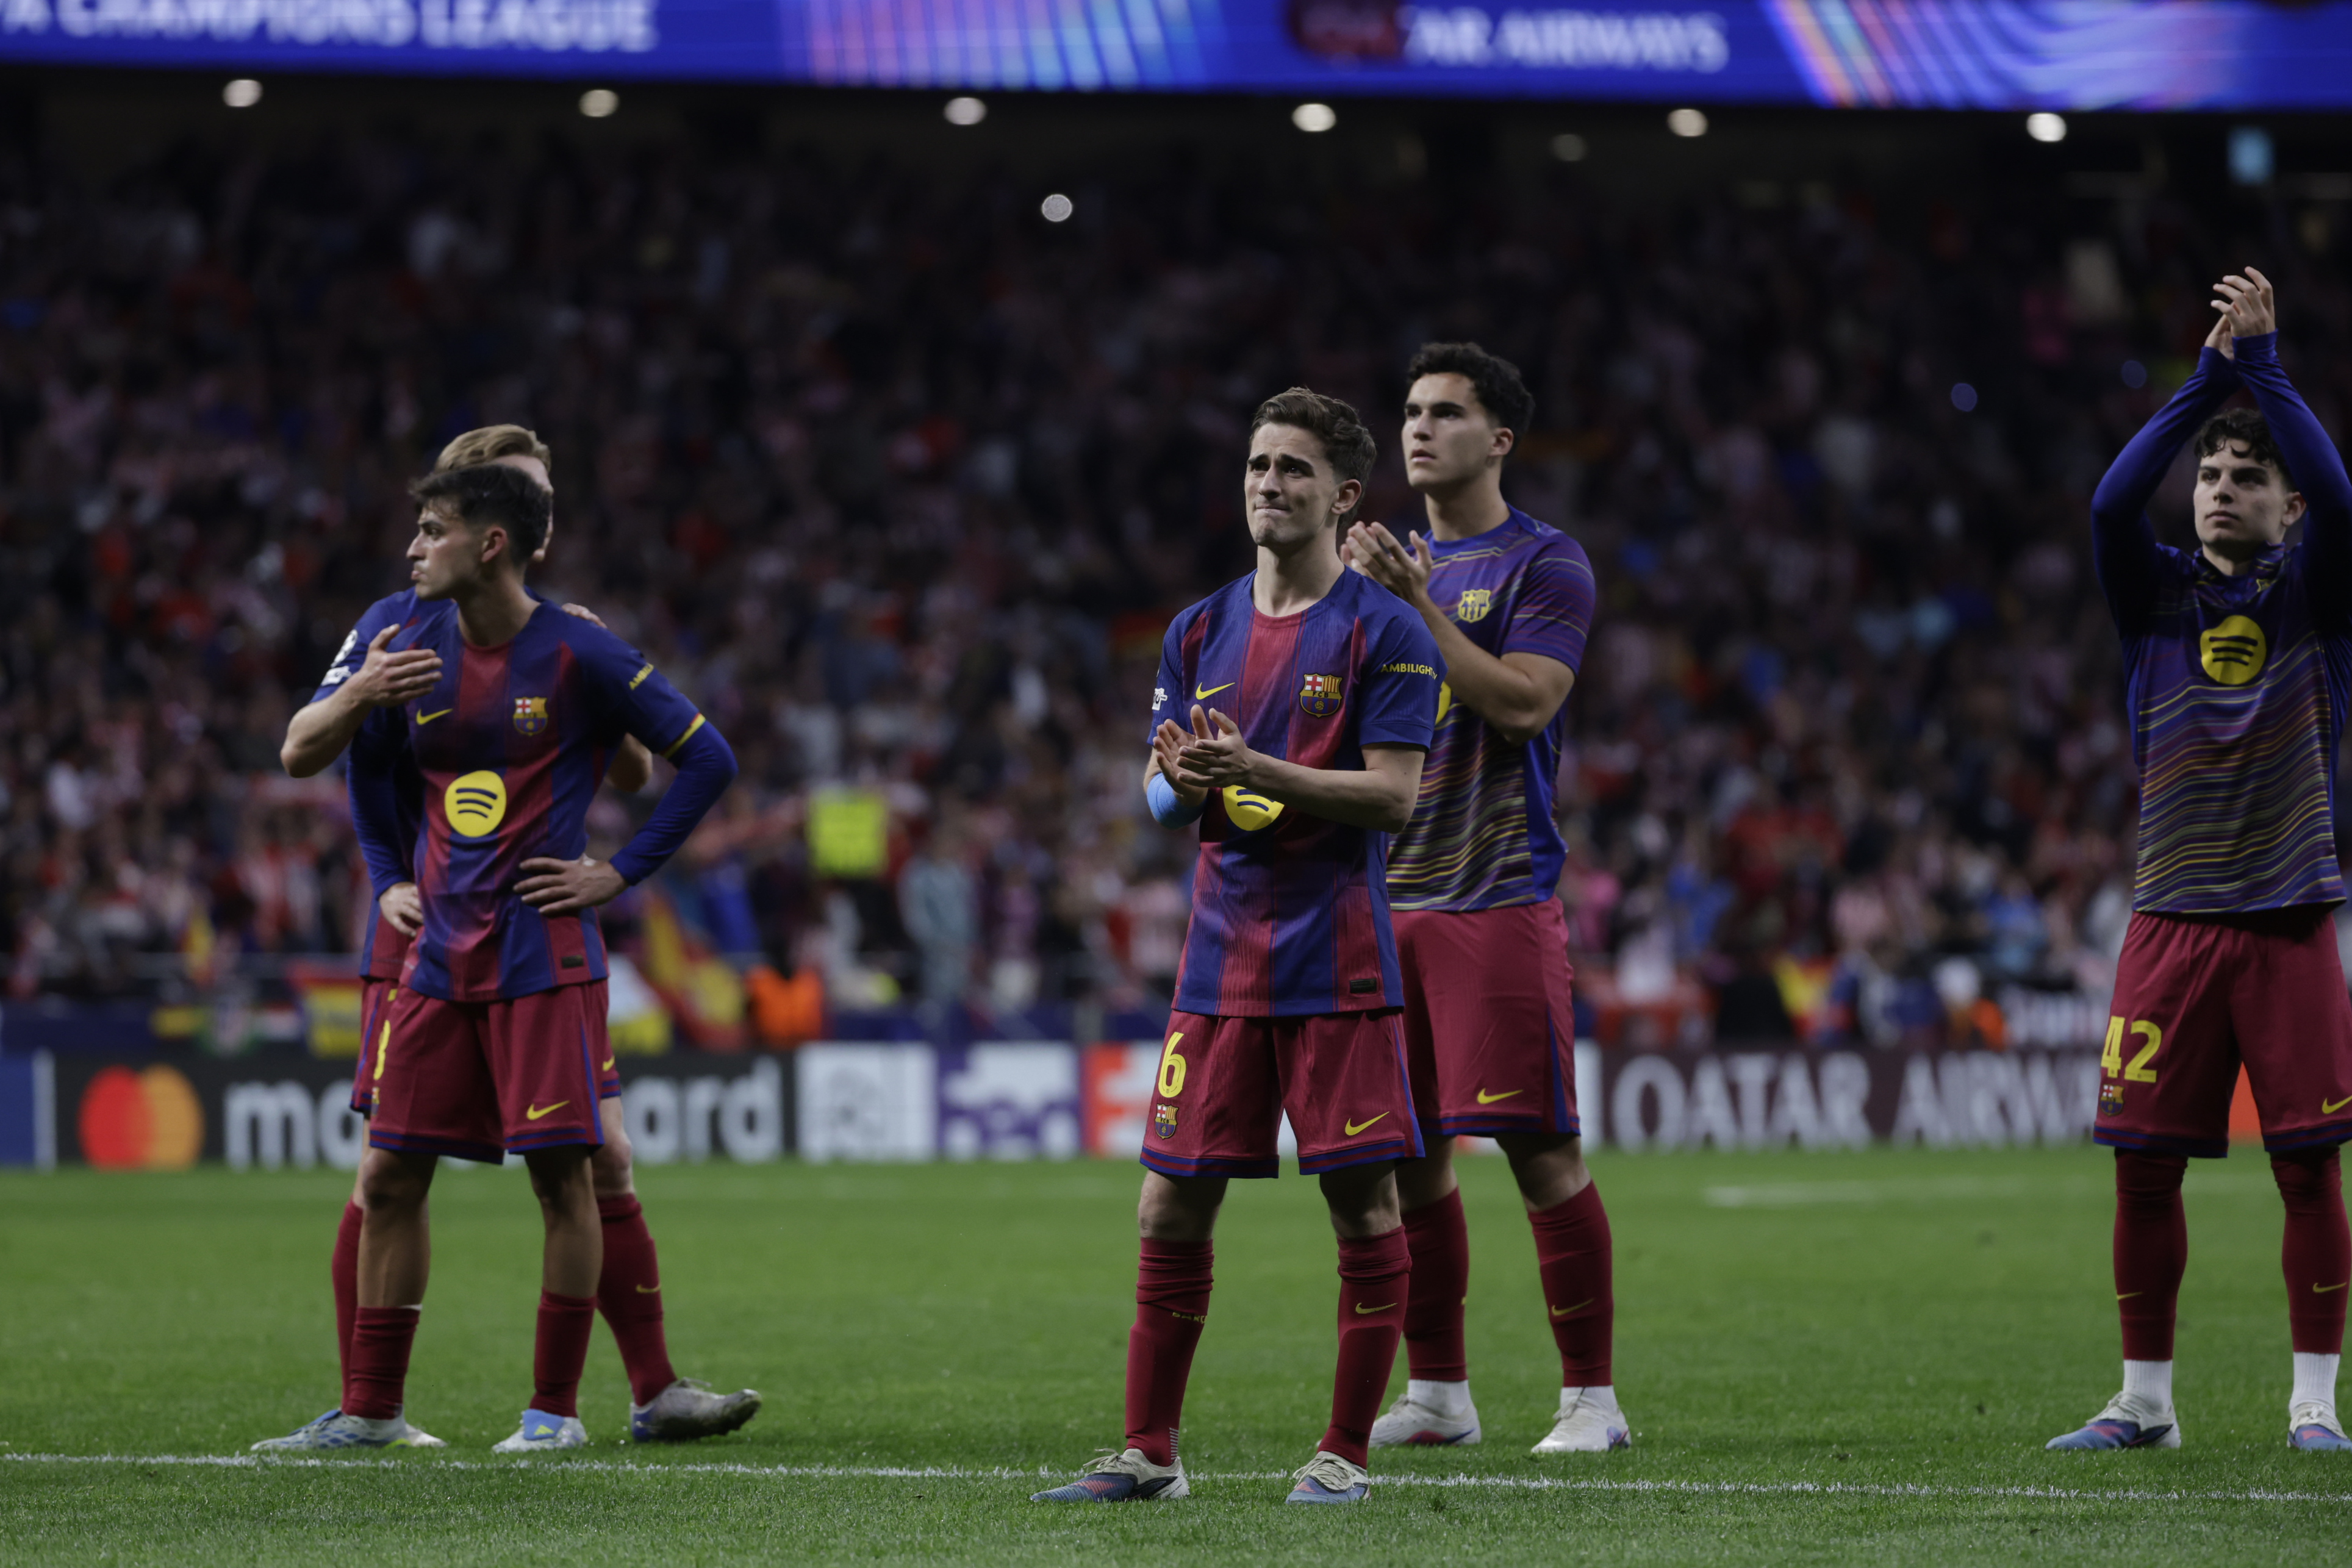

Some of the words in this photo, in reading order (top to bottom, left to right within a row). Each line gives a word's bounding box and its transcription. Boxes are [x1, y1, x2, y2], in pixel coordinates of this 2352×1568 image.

[421, 0, 659, 52] LEAGUE
[1158, 1031, 1186, 1098] 6
[2101, 1015, 2162, 1083] 42
